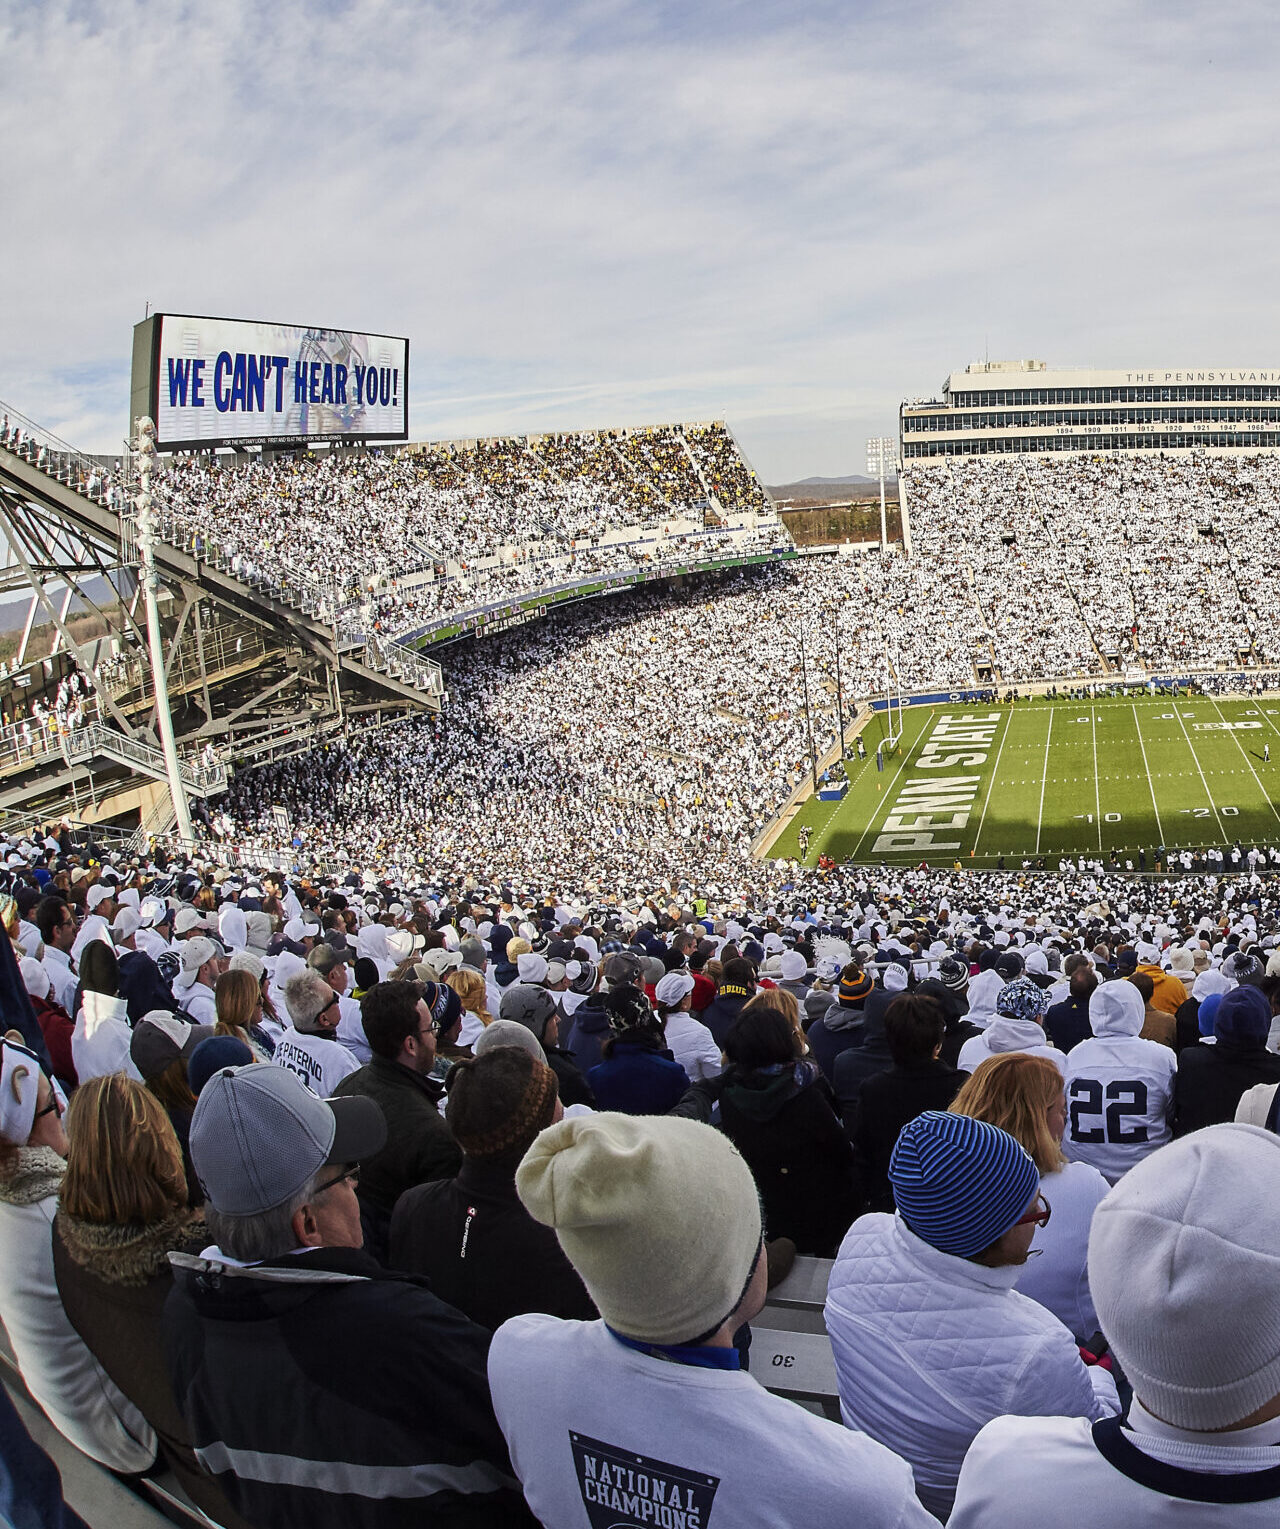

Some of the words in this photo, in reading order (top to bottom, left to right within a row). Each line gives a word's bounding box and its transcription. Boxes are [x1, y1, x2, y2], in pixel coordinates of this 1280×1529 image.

[168, 358, 206, 407] WE
[214, 351, 289, 412] CAN'T
[294, 361, 348, 404] HEAR
[355, 366, 399, 406] YOU!
[1126, 373, 1155, 382] THE
[914, 713, 1001, 765] STATE
[871, 776, 981, 853] PENN
[726, 984, 747, 996] BLUE
[284, 1042, 322, 1082] PATERNO
[1070, 1078, 1148, 1144] 22
[772, 1354, 795, 1367] 30
[584, 1455, 700, 1514] NATIONAL
[584, 1479, 700, 1529] CHAMPIONS
